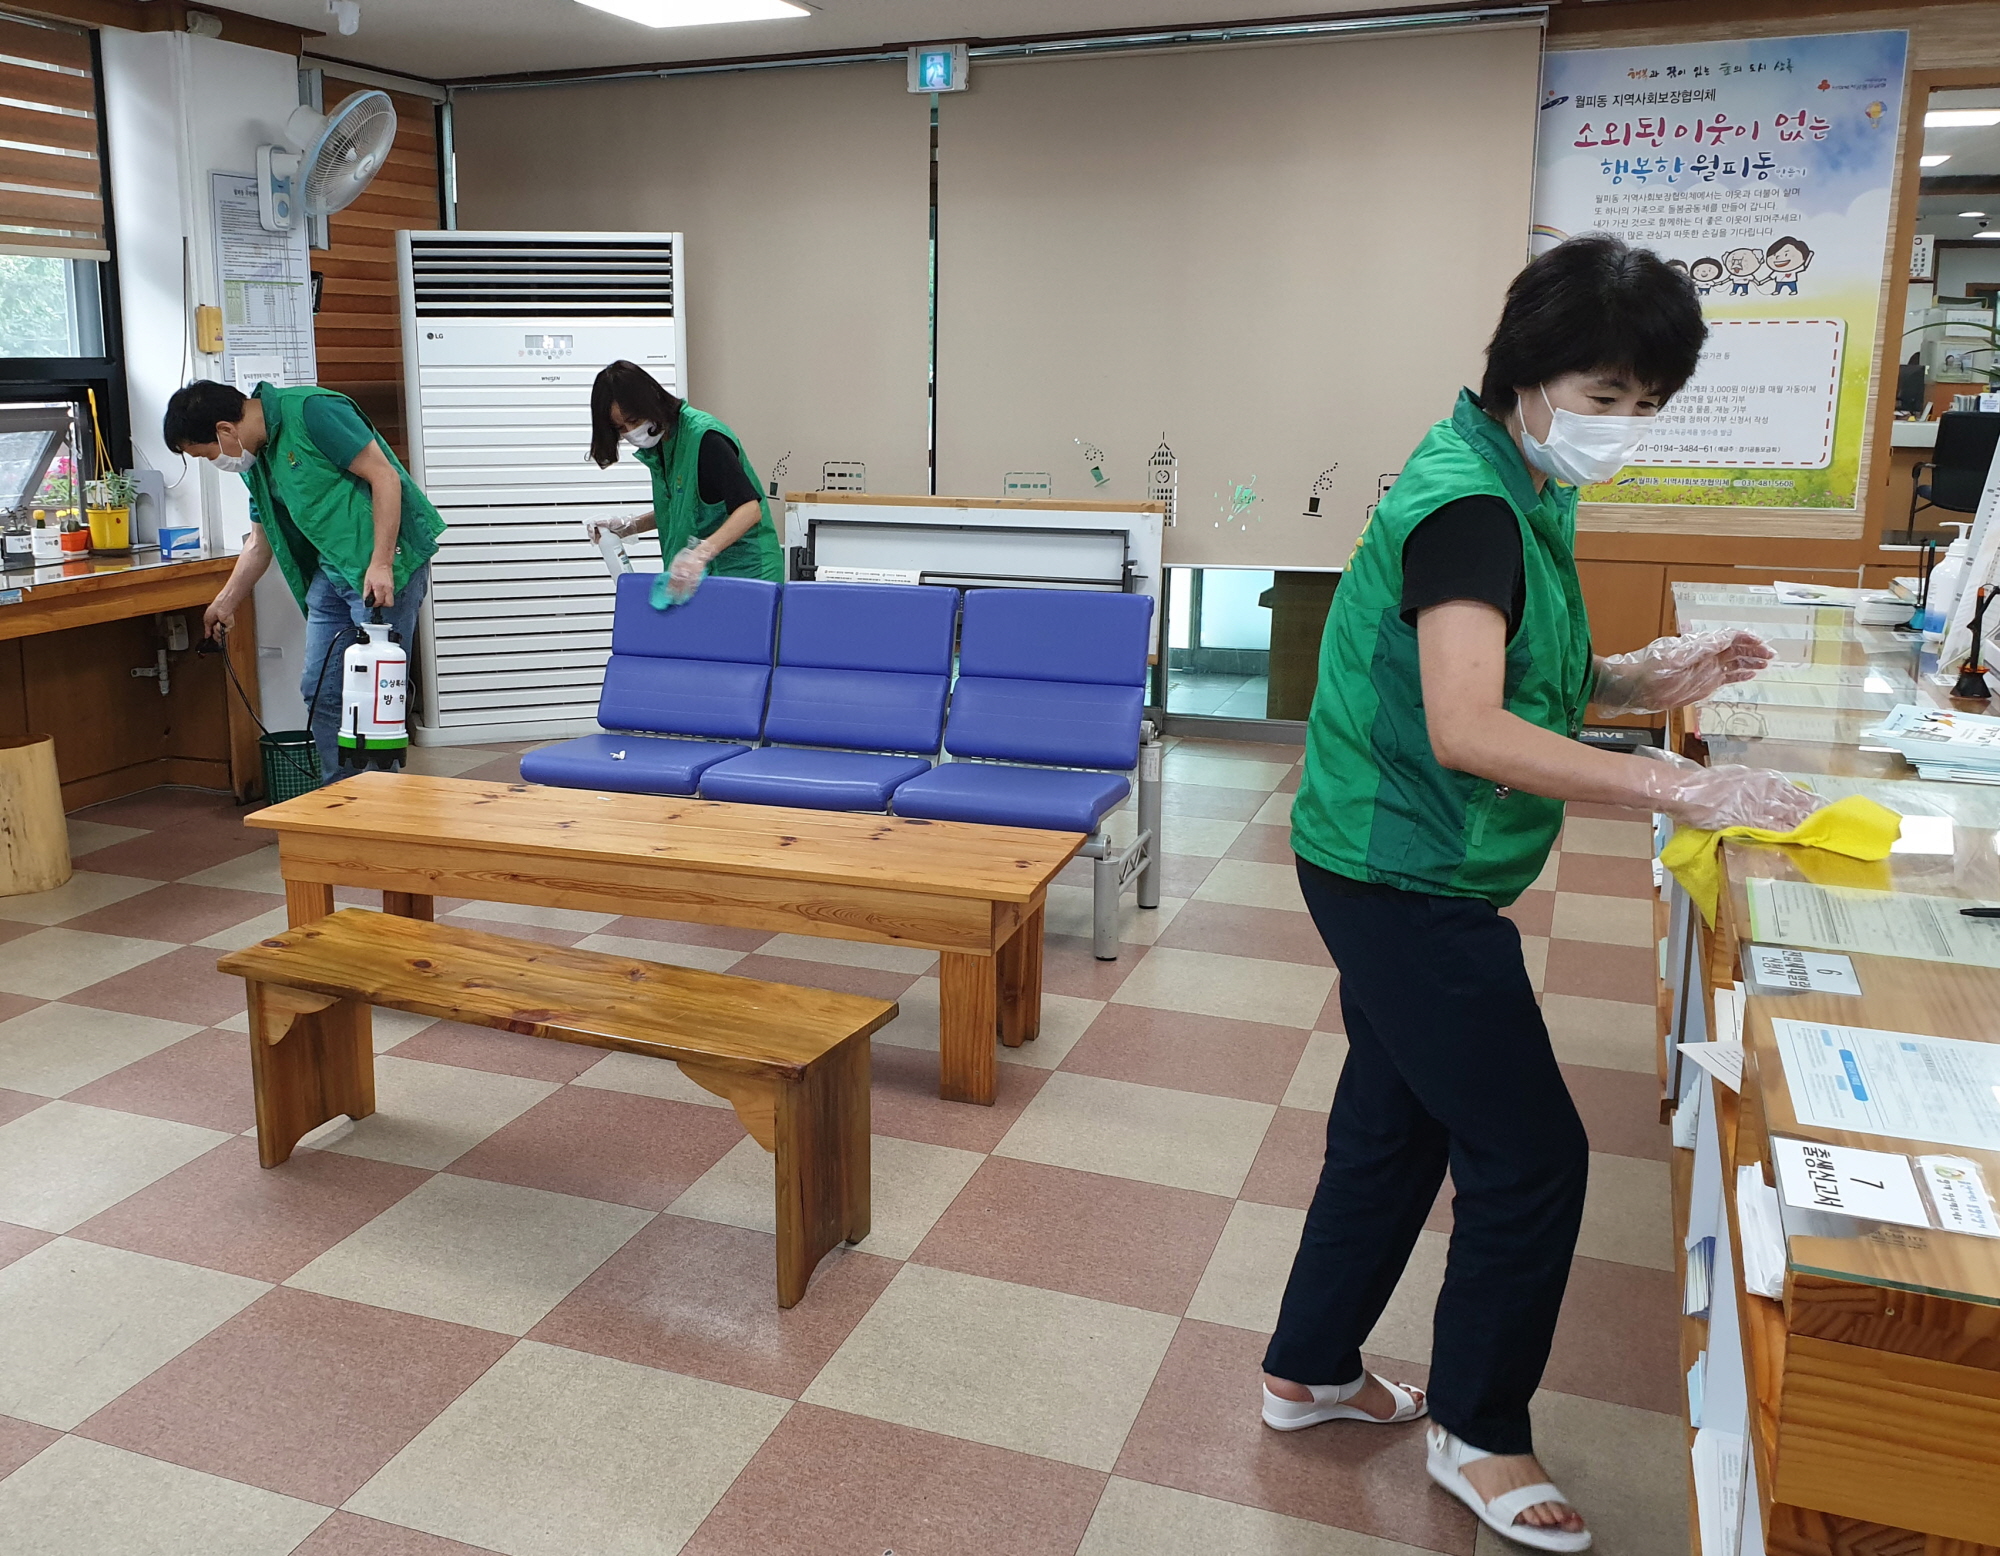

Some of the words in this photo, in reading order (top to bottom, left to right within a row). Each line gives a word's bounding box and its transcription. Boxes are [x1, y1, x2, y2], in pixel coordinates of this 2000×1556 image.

[1627, 68, 1660, 79] 행복과
[1693, 65, 1710, 78] 있는
[1749, 63, 1767, 72] 도시
[1574, 94, 1608, 109] 월피동
[1612, 88, 1717, 107] 지역사회보장협의체
[1573, 116, 1666, 148] 소외된
[1674, 113, 1760, 146] 이웃이
[1774, 109, 1831, 141] 없는
[1600, 155, 1686, 185] 행복한
[1689, 151, 1776, 182] 월피동
[1595, 193, 1619, 204] 월피동
[1622, 191, 1723, 203] 지역사회보장협의체에서는
[1725, 189, 1751, 199] 이웃과
[1753, 188, 1780, 198] 더불어
[1783, 187, 1801, 197] 살며
[1594, 207, 1602, 215] 또
[1605, 206, 1630, 215] 하나의
[1632, 205, 1665, 214] 가족으로
[1721, 203, 1747, 212] 만들어
[1593, 219, 1610, 228] 내가
[1612, 219, 1629, 228] 가진
[1631, 218, 1656, 227] 것으로
[1659, 217, 1692, 227] 함께하는
[1694, 216, 1703, 225] 더
[1705, 216, 1723, 226] 좋은
[1726, 215, 1752, 225] 이웃이
[1627, 231, 1644, 240] 많은
[1646, 230, 1671, 239] 관심과
[1673, 229, 1699, 239] 따뜻한
[1702, 228, 1727, 238] 손길을
[1709, 385, 1738, 394] 3,000원
[1767, 384, 1783, 394] 매월
[1786, 384, 1817, 394] 자동이체
[1731, 395, 1746, 404] 기부
[1663, 405, 1678, 414] 요한
[1732, 405, 1747, 414] 기부
[1713, 415, 1727, 424] 기부
[1754, 415, 1769, 425] 작성
[1761, 956, 1787, 977] 신청서
[1816, 968, 1843, 976] 6
[1801, 1146, 1845, 1208] 출생신고서
[1849, 1177, 1885, 1190] 7
